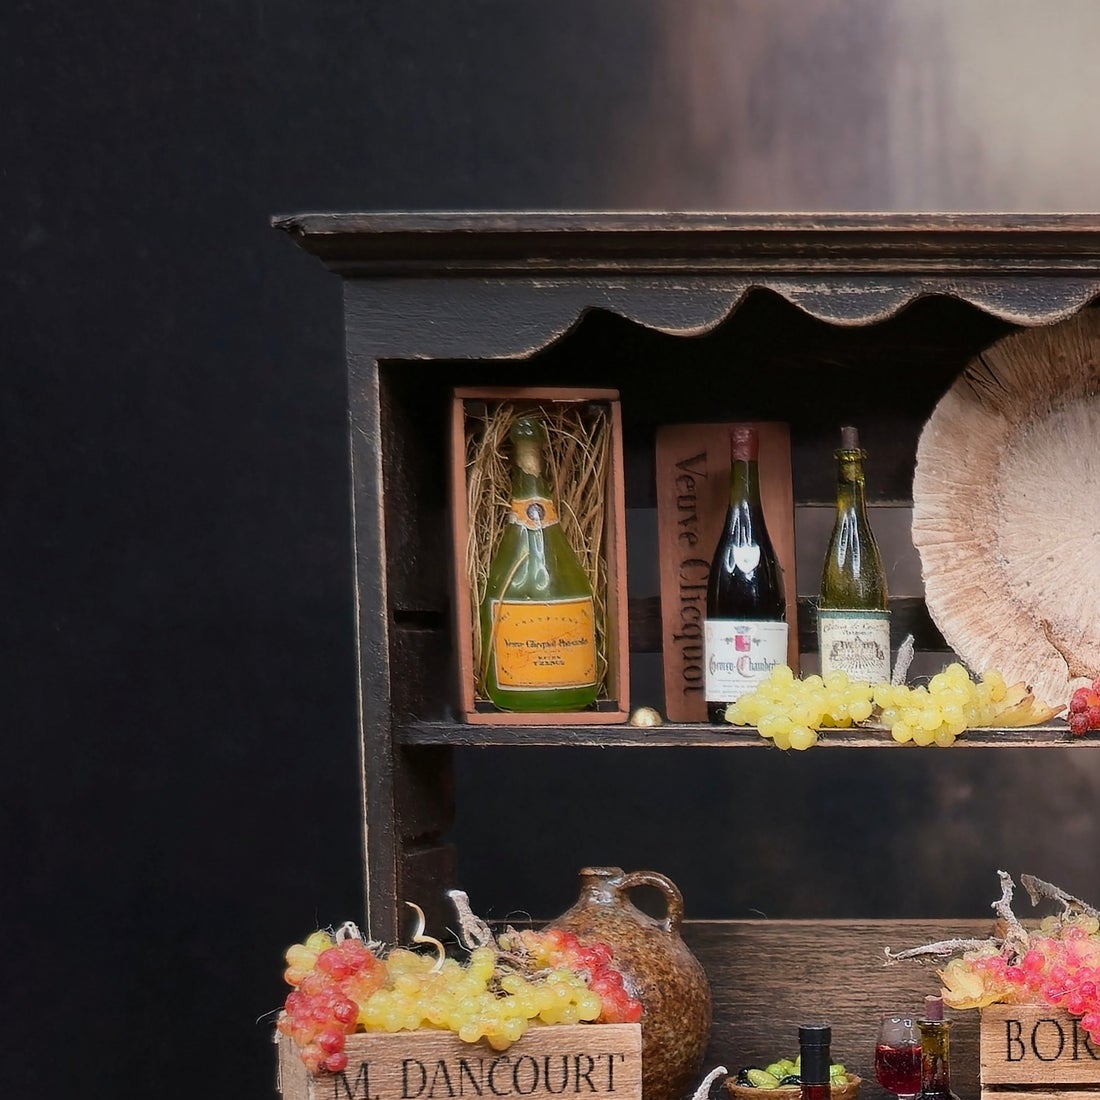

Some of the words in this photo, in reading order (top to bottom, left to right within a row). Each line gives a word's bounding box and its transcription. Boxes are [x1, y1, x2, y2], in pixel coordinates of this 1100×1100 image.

[676, 452, 707, 546] Veuve
[672, 558, 710, 697] Clicquot
[400, 1052, 626, 1100] DANCOURT
